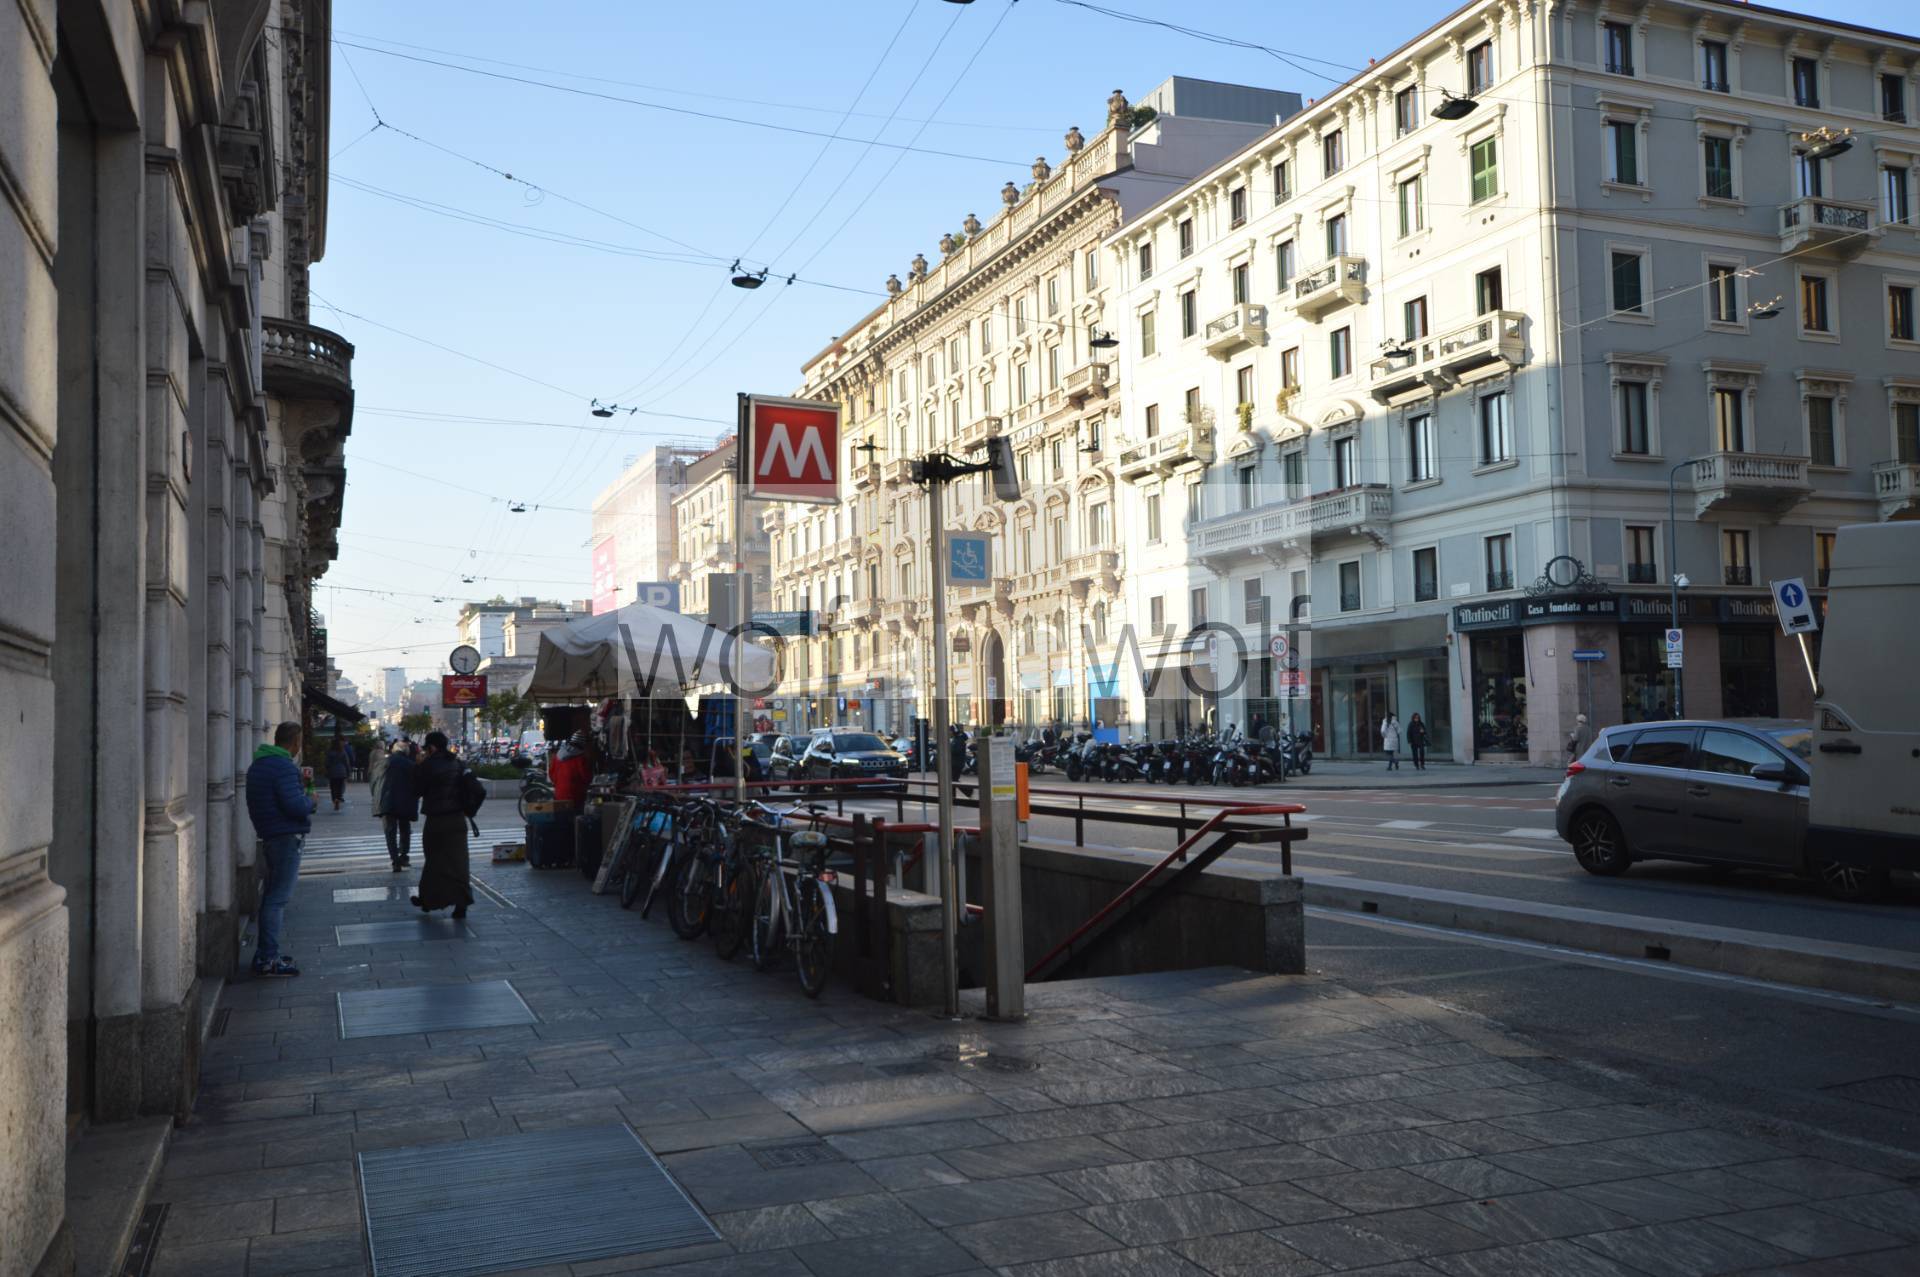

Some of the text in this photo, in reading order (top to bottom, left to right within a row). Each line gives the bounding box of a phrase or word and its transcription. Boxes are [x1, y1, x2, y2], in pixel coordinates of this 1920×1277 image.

[758, 423, 833, 480] M
[647, 586, 672, 607] P
[1527, 604, 1544, 615] Casa
[1549, 601, 1581, 613] fondata
[1274, 642, 1285, 653] 30
